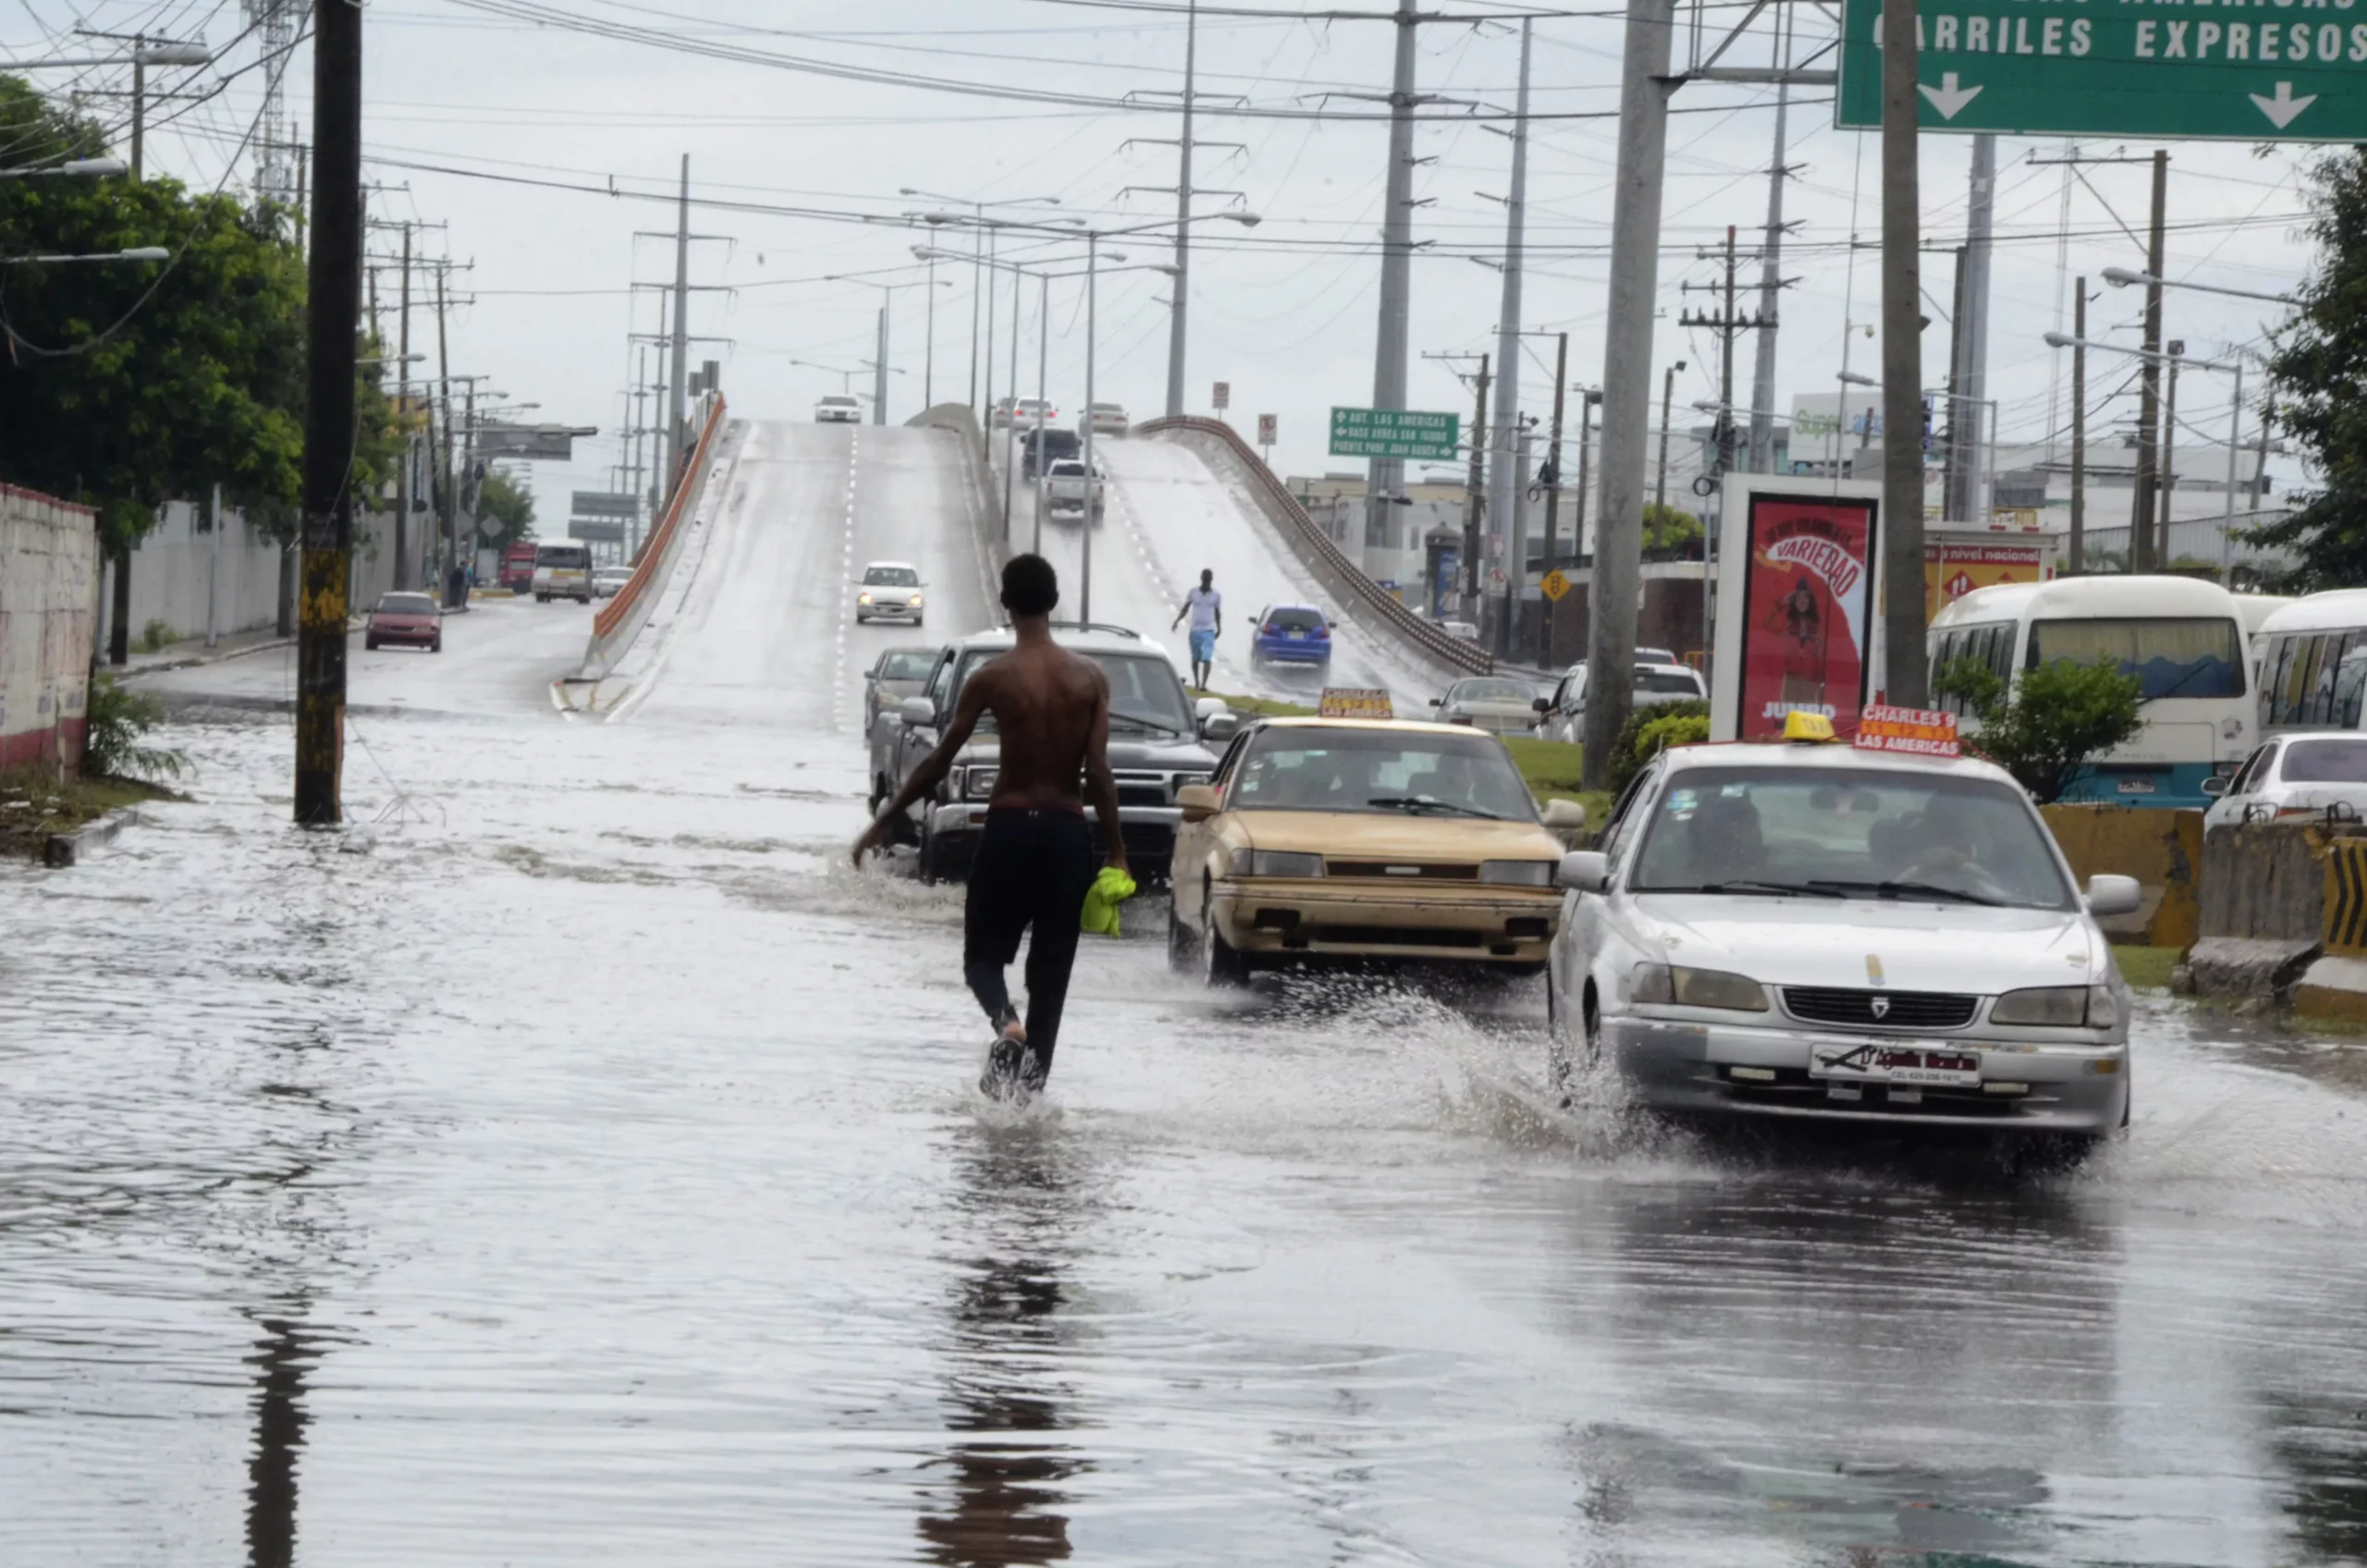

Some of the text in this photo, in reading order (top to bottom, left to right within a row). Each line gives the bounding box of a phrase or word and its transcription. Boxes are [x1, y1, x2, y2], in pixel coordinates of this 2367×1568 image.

[2135, 19, 2367, 62] EXPRESOS
[1374, 414, 1392, 426] LAS
[1397, 415, 1446, 429] AMERICAS
[1950, 547, 1982, 561] nivel
[1862, 705, 1942, 728] CHARLES
[1855, 734, 1959, 755] LAS AMERICAS
